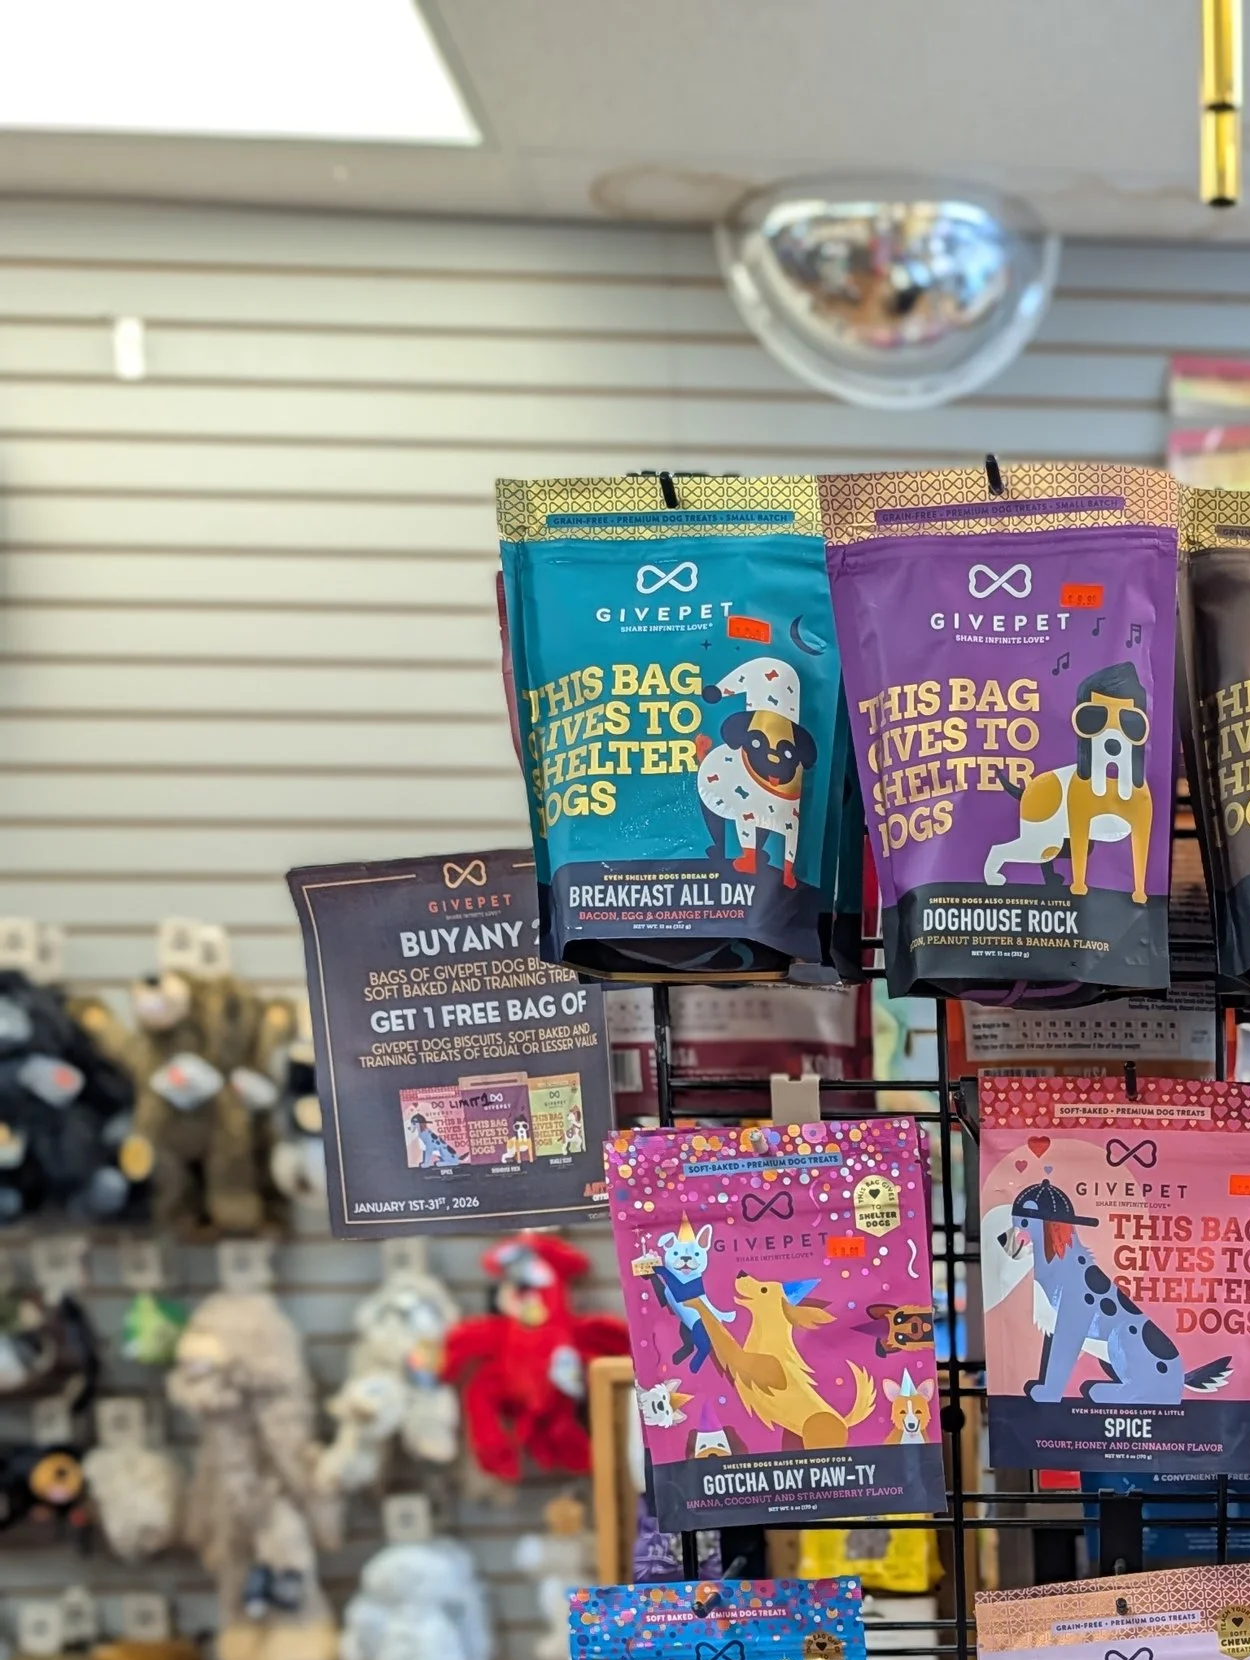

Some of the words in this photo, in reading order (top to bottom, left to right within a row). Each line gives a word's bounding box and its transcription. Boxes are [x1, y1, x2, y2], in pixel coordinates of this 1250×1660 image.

[596, 602, 732, 622] GIVEPET
[931, 613, 1070, 631] GIVEPET
[428, 894, 512, 914] GIVEPET
[570, 884, 674, 908] BREAKFAST
[681, 885, 714, 906] ALL
[721, 884, 755, 906] DAY
[923, 908, 1021, 931] DOGHOUSE
[1028, 911, 1078, 934] ROCK
[369, 971, 407, 986] BAGS
[411, 968, 430, 982] OF
[434, 963, 488, 980] GIVEPET
[492, 959, 525, 973] DOG
[365, 987, 400, 1002] SOFT
[403, 982, 447, 998] BAKED
[451, 979, 481, 994] AND
[485, 971, 545, 989] TRAINING
[371, 1009, 418, 1033] GET
[424, 1007, 435, 1028] 1
[443, 1003, 501, 1027] FREE
[508, 997, 558, 1022] BAG
[562, 991, 587, 1015] OF
[360, 1054, 417, 1068] TRAINING
[420, 1051, 460, 1063] TREATS
[464, 1048, 480, 1060] OF
[483, 1045, 520, 1059] EQUAL
[523, 1042, 539, 1055] OR
[542, 1038, 573, 1052] LESSER
[575, 1033, 598, 1048] VALUE
[372, 1039, 419, 1056] GIVEPET
[423, 1038, 451, 1051] DOG
[454, 1033, 506, 1049] BISCUITS,
[509, 1029, 536, 1043] SOFT
[539, 1026, 570, 1039] BAKED
[573, 1023, 590, 1036] AND
[1060, 1107, 1109, 1115] SOFT-BAKED
[1116, 1108, 1154, 1116] PREMIUM
[1157, 1108, 1174, 1116] DOG
[1176, 1109, 1205, 1117] TREATS
[1076, 1182, 1188, 1198] GIVEPET
[354, 1201, 406, 1213] JANUARY
[452, 1197, 479, 1209] 2026
[1109, 1214, 1192, 1241] THIS
[1113, 1245, 1214, 1272] GIVES
[1104, 1418, 1152, 1438] SPICE
[1036, 1440, 1073, 1449] YOGURT,
[1075, 1441, 1107, 1450] HONEY
[1109, 1442, 1129, 1450] AND
[1131, 1442, 1185, 1451] CINNAMON
[1187, 1443, 1223, 1452] FLAVOR
[703, 1472, 768, 1495] GOTCHA
[775, 1470, 803, 1491] DAY
[810, 1465, 876, 1488] PAW-TY
